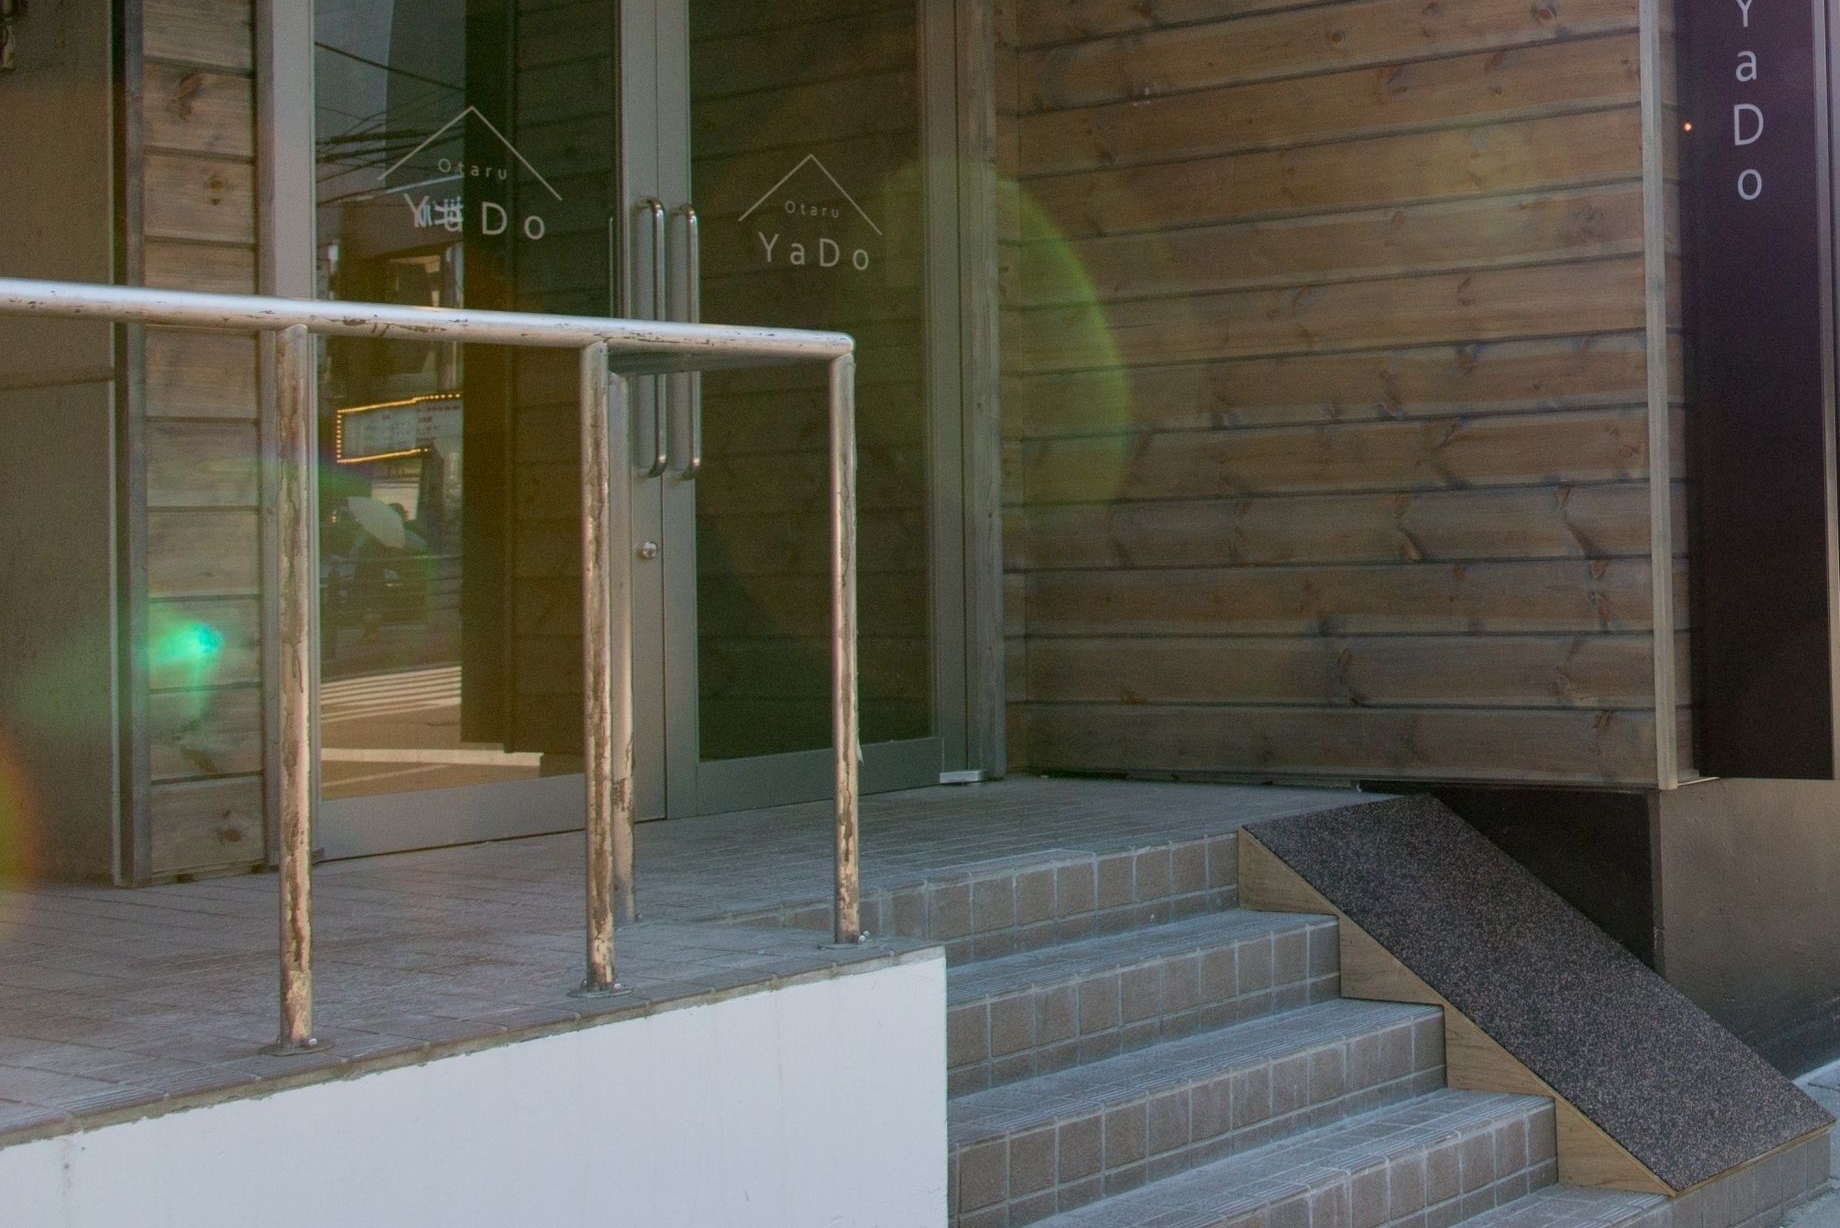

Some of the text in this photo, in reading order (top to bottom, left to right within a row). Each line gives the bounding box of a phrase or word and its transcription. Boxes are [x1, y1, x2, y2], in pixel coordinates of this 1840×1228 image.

[437, 157, 508, 180] Otaru
[402, 192, 546, 241] YaDo
[784, 199, 840, 219] Otaru
[757, 231, 870, 272] YaDo
